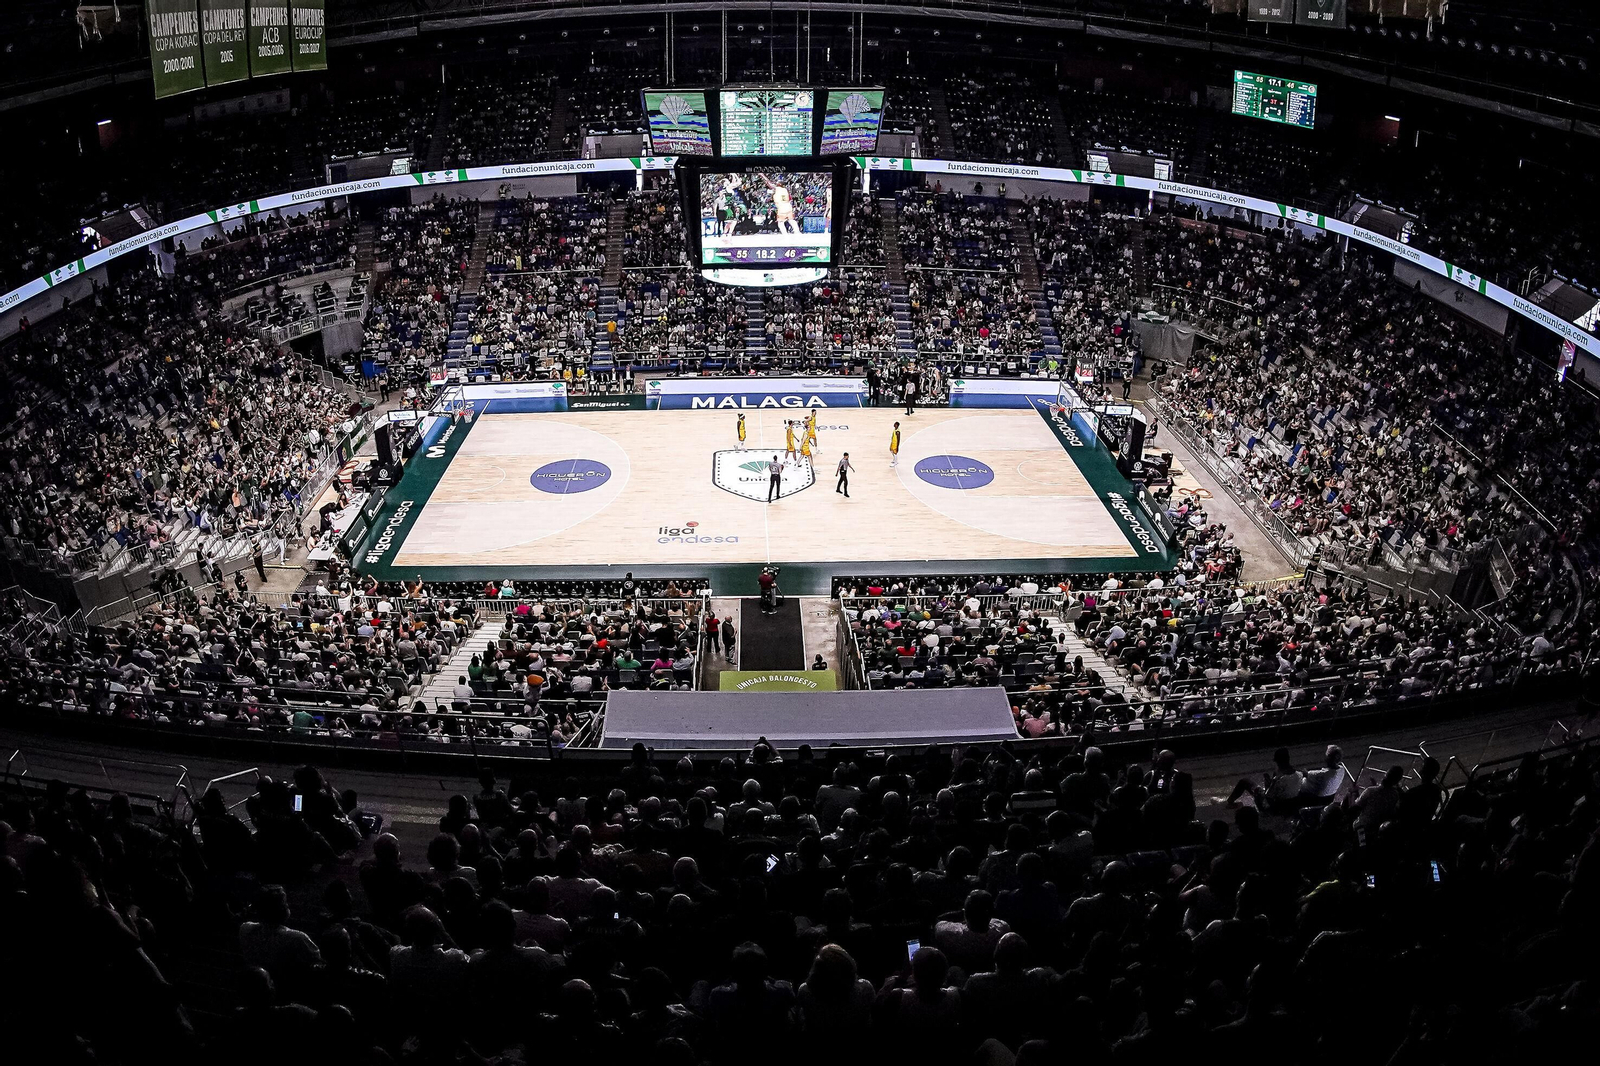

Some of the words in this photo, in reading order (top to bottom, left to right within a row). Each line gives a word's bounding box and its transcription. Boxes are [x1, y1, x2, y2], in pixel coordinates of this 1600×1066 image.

[150, 11, 198, 37] CAMPEONES
[203, 9, 244, 31] CAMPEONES
[251, 7, 288, 26] CAMPEONES
[292, 8, 325, 26] CAMPEONES
[204, 32, 221, 44] COPA
[222, 30, 234, 42] DEL
[234, 30, 246, 41] REY
[262, 28, 280, 44] ACB
[294, 26, 323, 40] EUROCUP
[156, 38, 174, 52] COPA
[220, 50, 234, 63] 2005
[164, 56, 194, 74] 2000/2001
[1268, 78, 1282, 87] 17.1
[502, 162, 595, 175] fundacionunicaja.com
[947, 162, 1039, 176] fundacionunicaja.com
[291, 180, 381, 200] fundacionunicaja.com
[1158, 182, 1246, 205] fundacionunicaja.com
[108, 223, 180, 257] fundacionunicaja.com
[1353, 228, 1420, 260] fundacionunicaja.com
[736, 250, 748, 258] 55
[756, 250, 776, 258] 18.2
[784, 250, 796, 258] 46
[1512, 297, 1588, 346] fundacionunicaja.com
[691, 395, 828, 408] MÁLAGA
[1051, 416, 1084, 446] endesa
[1107, 491, 1160, 553] #ligaendesa
[364, 500, 414, 564] #ligaendesa
[658, 526, 694, 536] liga
[657, 534, 739, 544] endesa
[736, 675, 767, 690] UNICAJA
[768, 675, 818, 689] BALONCESTO
